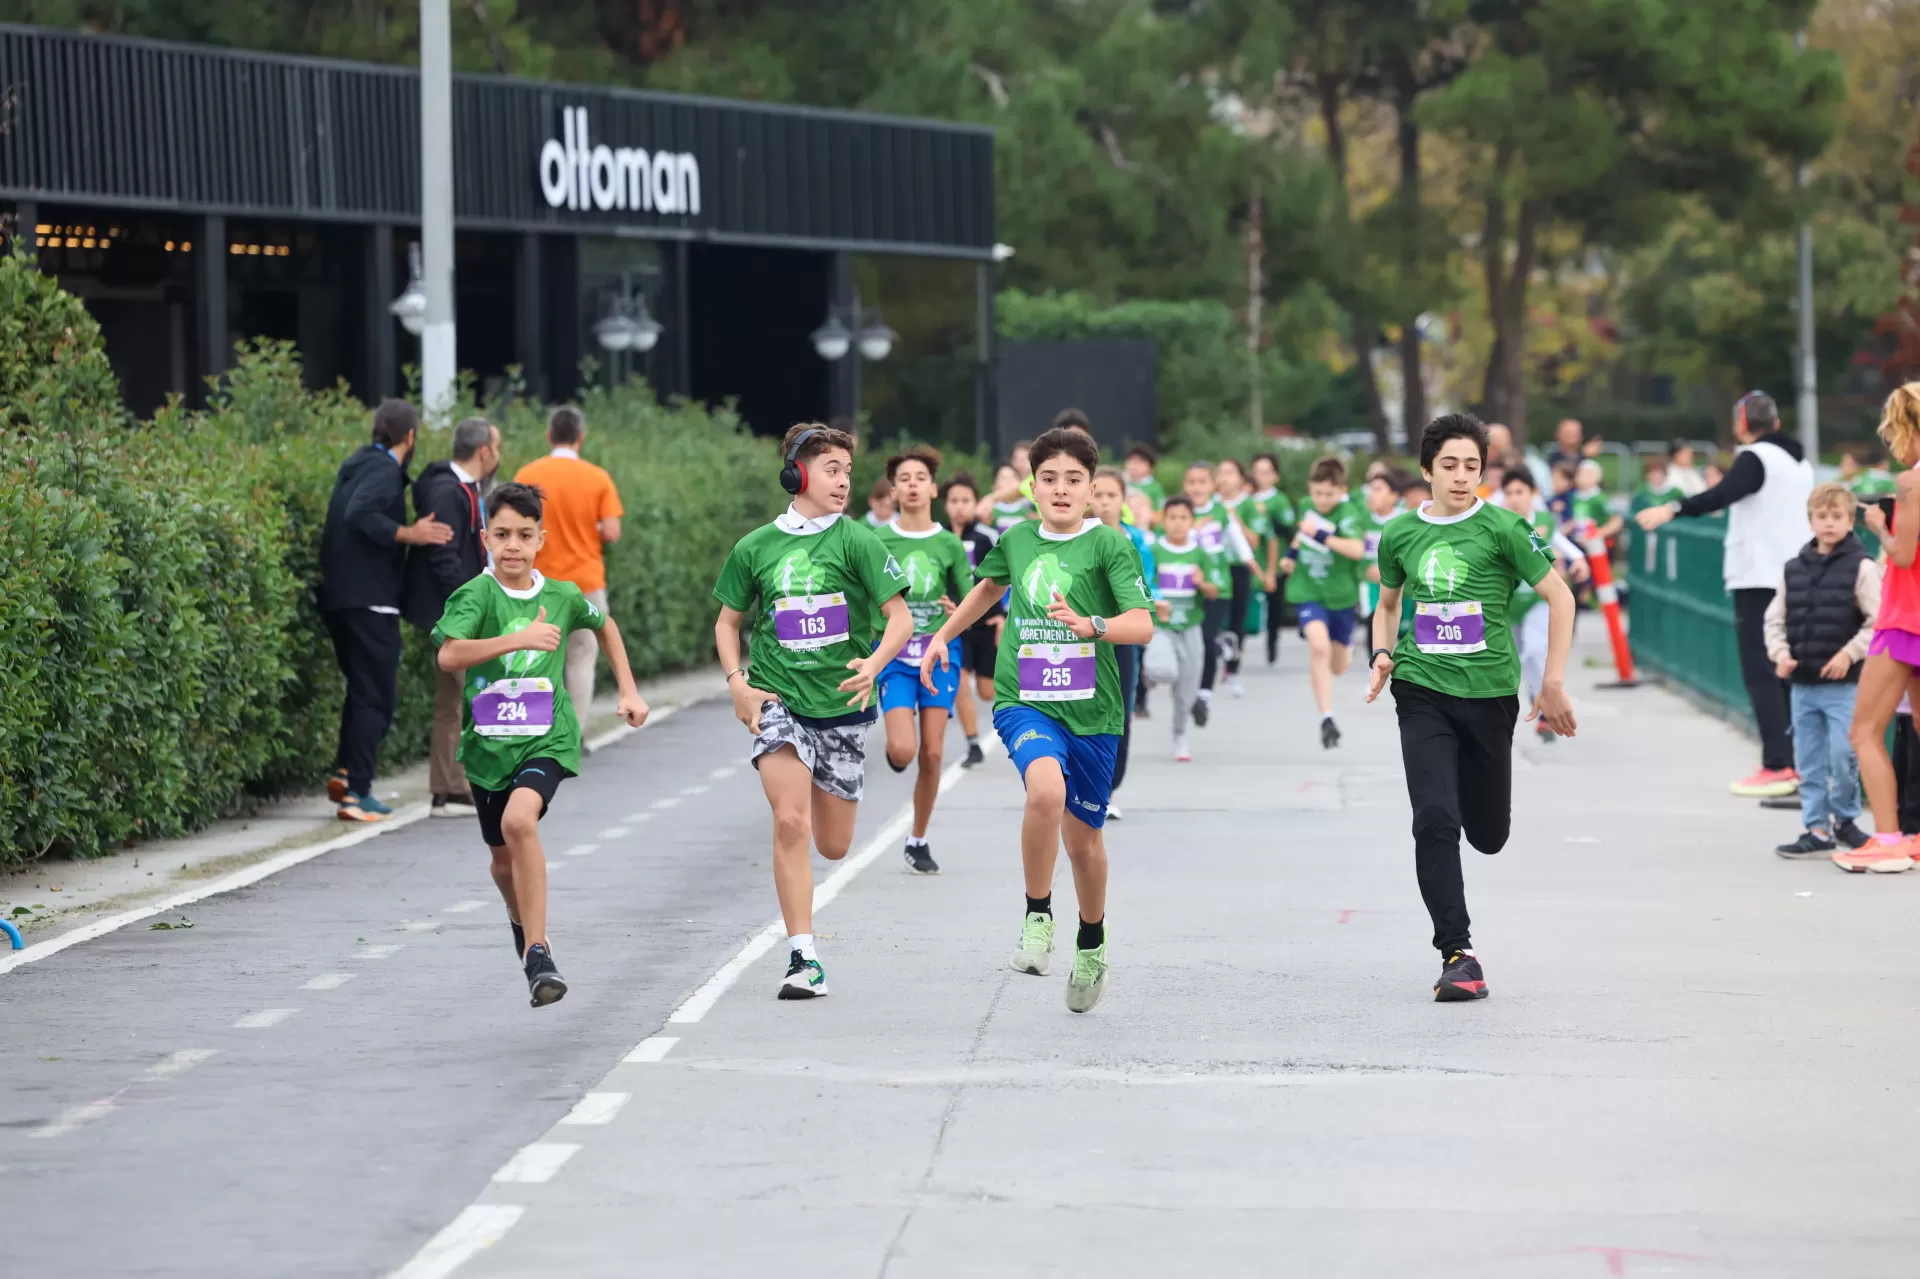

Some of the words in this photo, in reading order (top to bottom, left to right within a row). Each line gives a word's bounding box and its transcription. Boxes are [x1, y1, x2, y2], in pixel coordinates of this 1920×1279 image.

[799, 616, 826, 635] 163
[1436, 624, 1462, 641] 206
[1042, 667, 1072, 687] 255
[496, 701, 528, 721] 234
